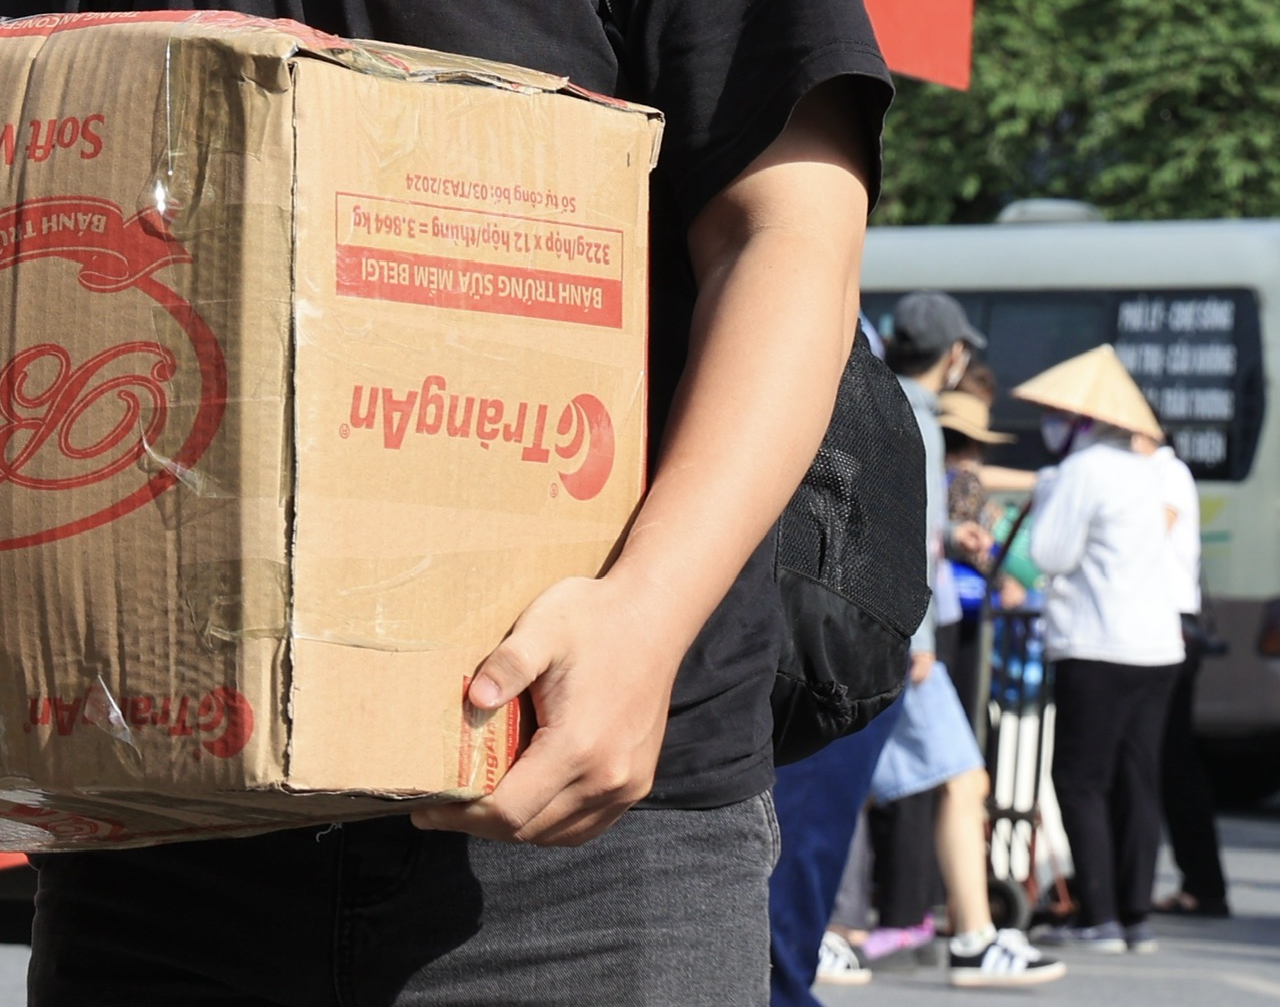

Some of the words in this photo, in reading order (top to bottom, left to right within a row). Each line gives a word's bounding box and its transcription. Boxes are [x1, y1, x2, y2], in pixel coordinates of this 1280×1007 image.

[26, 114, 106, 163] Soft
[405, 173, 488, 198] 03/TA3/2024
[42, 213, 107, 238] BÁNH
[352, 205, 373, 234] kg
[375, 212, 416, 238] 3.864
[431, 216, 511, 252] hộp/thùng
[514, 232, 531, 254] 12
[533, 236, 543, 250] x
[545, 231, 611, 265] 322g/hộp
[361, 257, 409, 284] BELGI
[413, 264, 453, 297] MỀM
[458, 271, 494, 301] SỮA
[498, 275, 555, 306] TRỨNG
[558, 281, 603, 313] BÁNH
[349, 376, 550, 463] TràngAn
